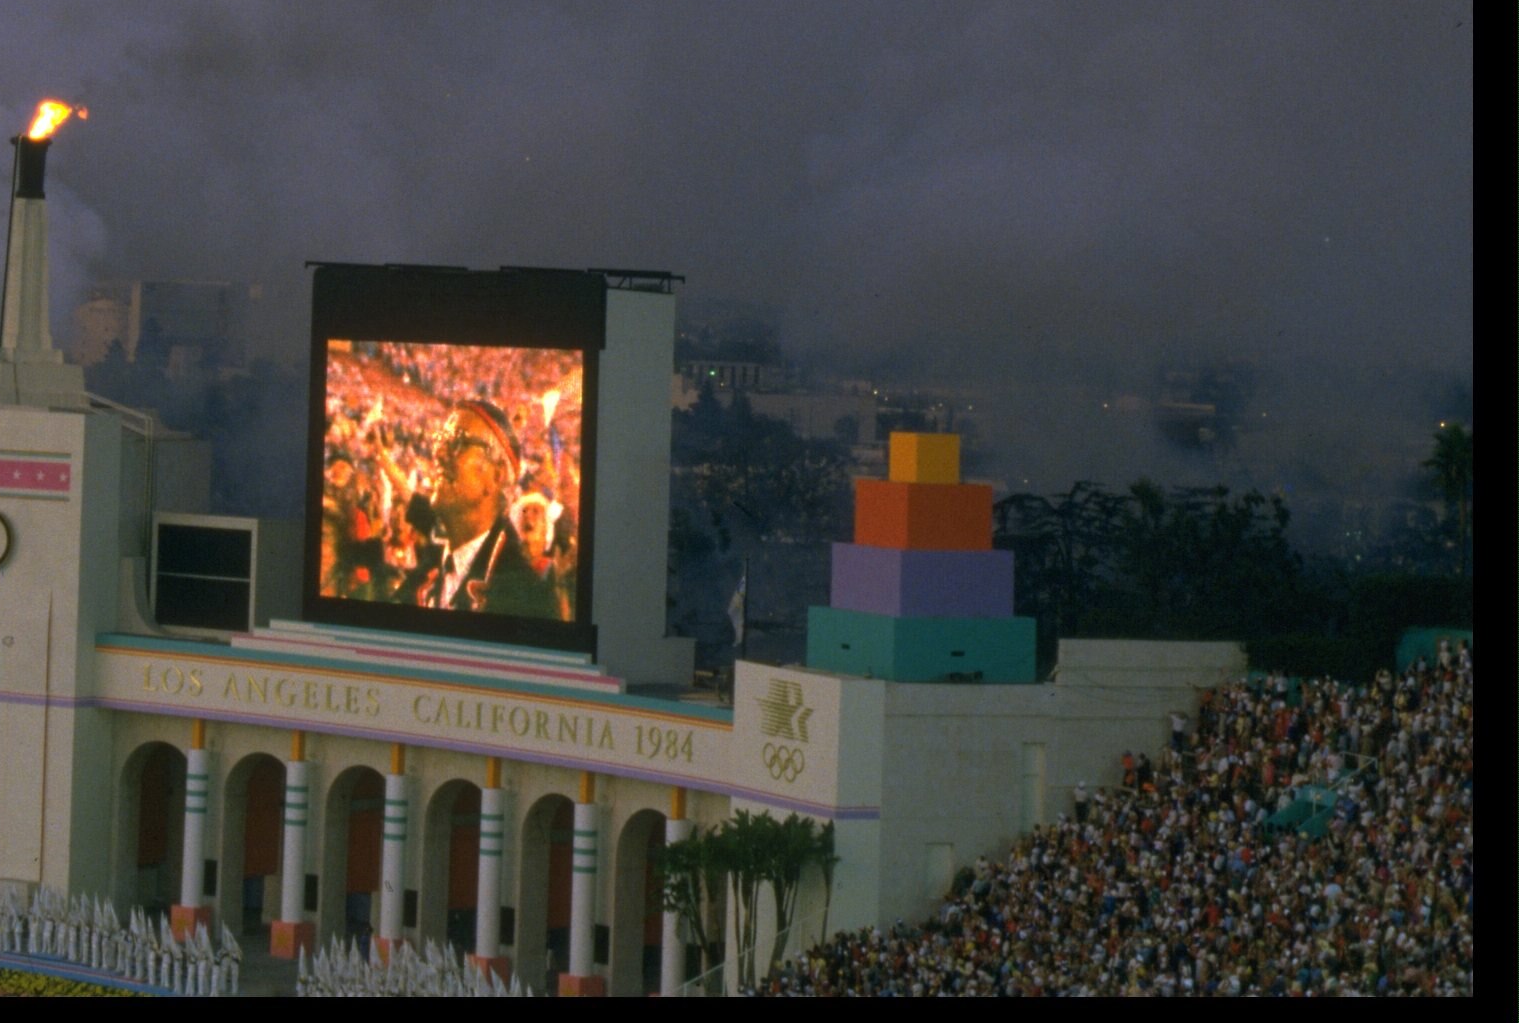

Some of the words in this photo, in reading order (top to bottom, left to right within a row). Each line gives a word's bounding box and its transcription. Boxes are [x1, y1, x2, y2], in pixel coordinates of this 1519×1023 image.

[142, 662, 204, 698] LOS
[223, 671, 380, 718] ANGELES
[412, 693, 615, 751] CALIFORNIA
[634, 723, 695, 764] 1984
